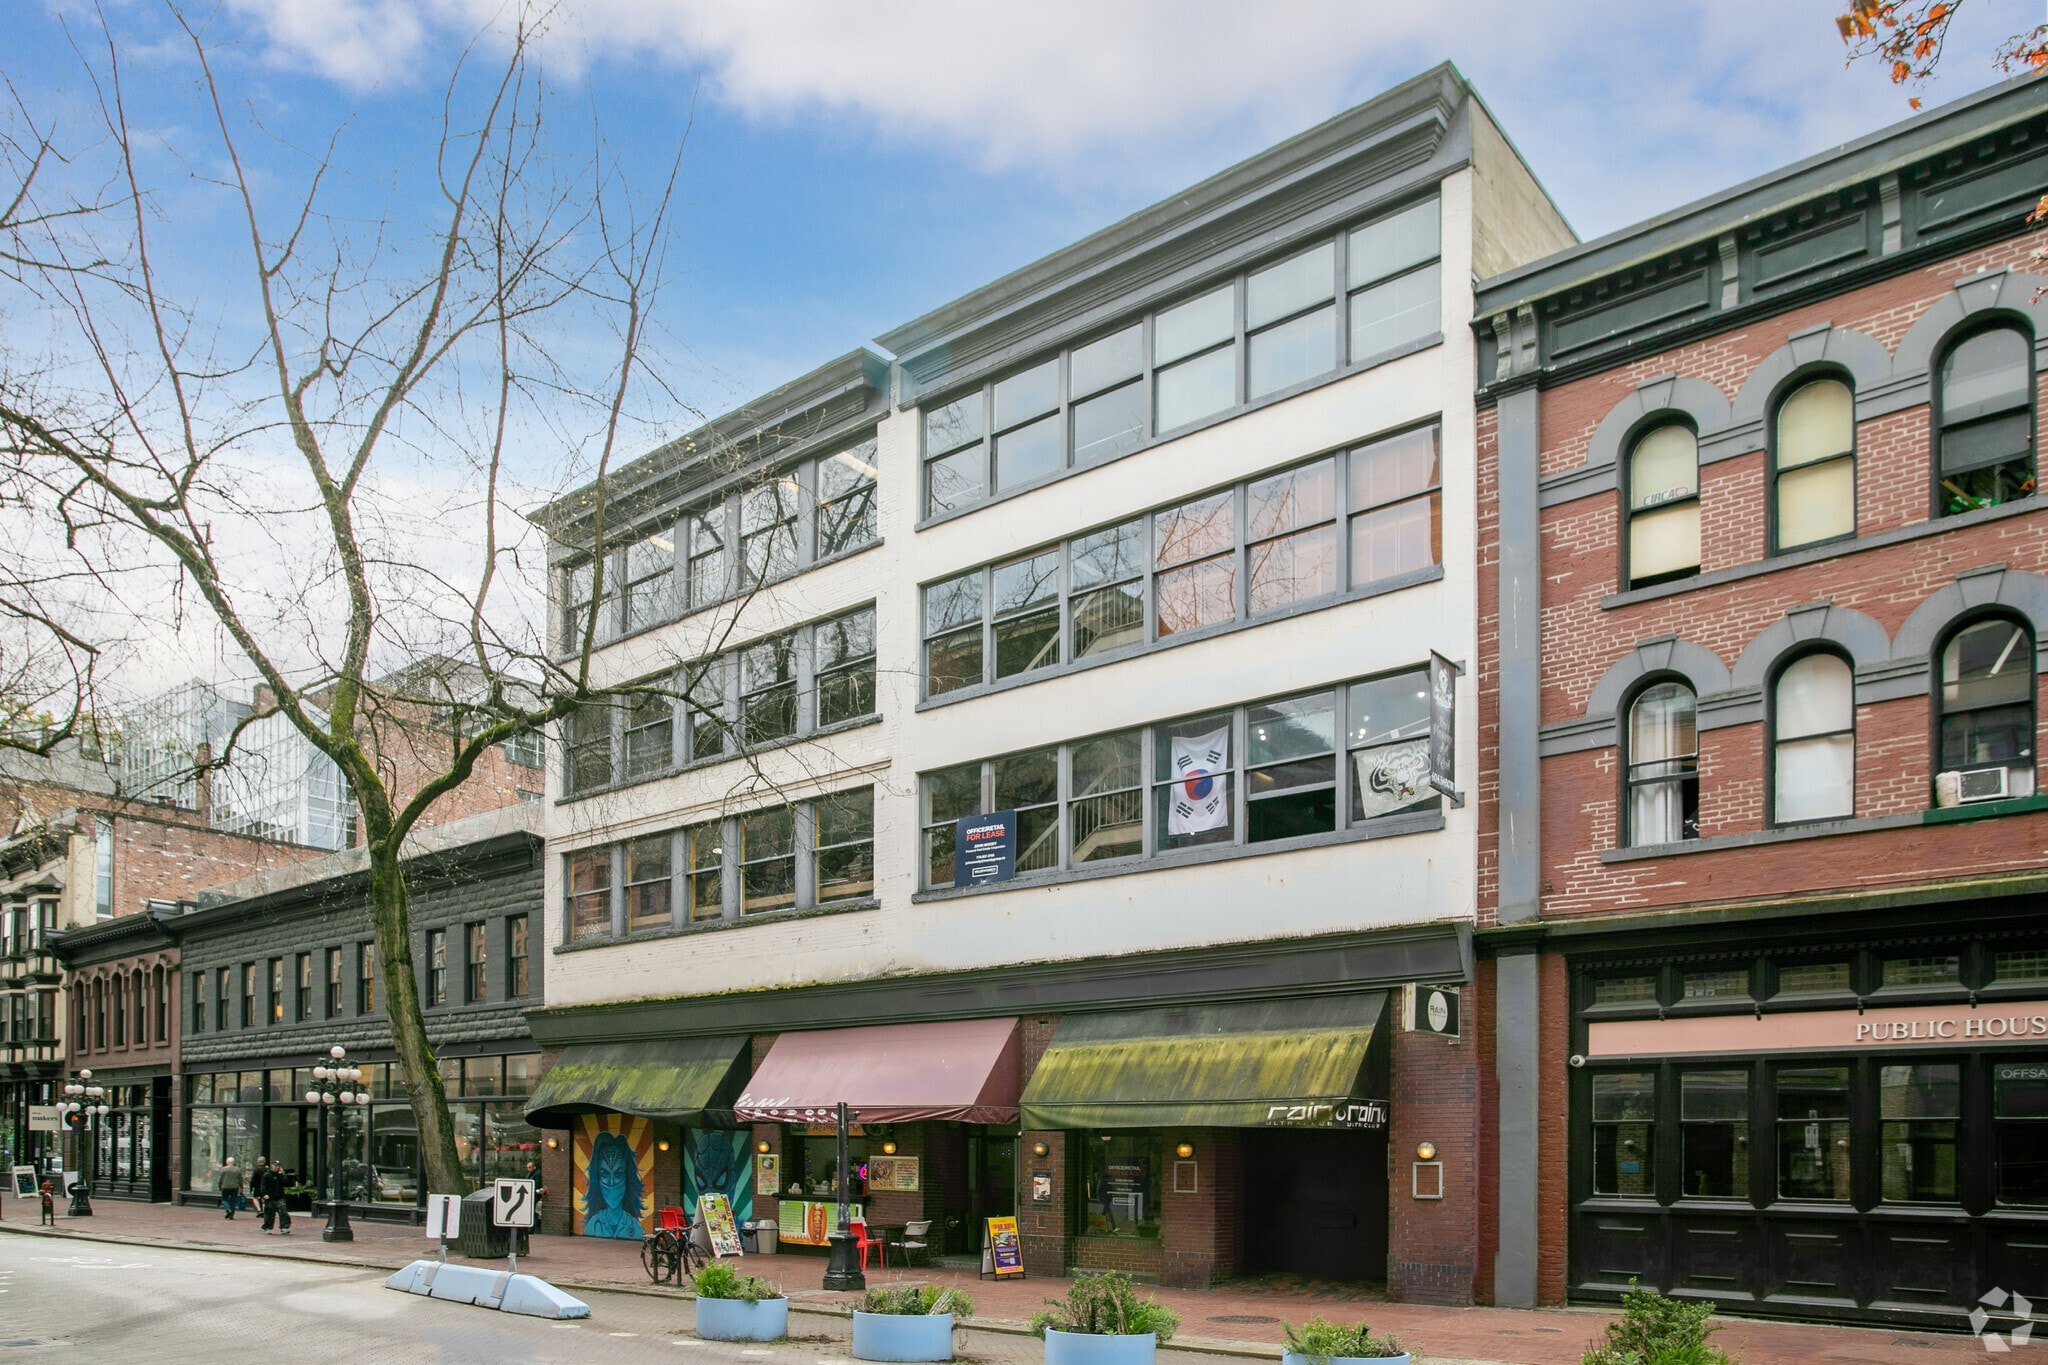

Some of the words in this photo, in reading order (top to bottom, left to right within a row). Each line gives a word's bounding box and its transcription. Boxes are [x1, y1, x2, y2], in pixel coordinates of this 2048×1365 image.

[1643, 489, 1675, 505] CIRCA
[966, 833, 981, 841] FOR
[982, 829, 1005, 840] LEASE
[1856, 1019, 1956, 1041] PUBLIC
[1964, 1016, 2048, 1037] HOUS
[2001, 1068, 2048, 1079] OFFSA
